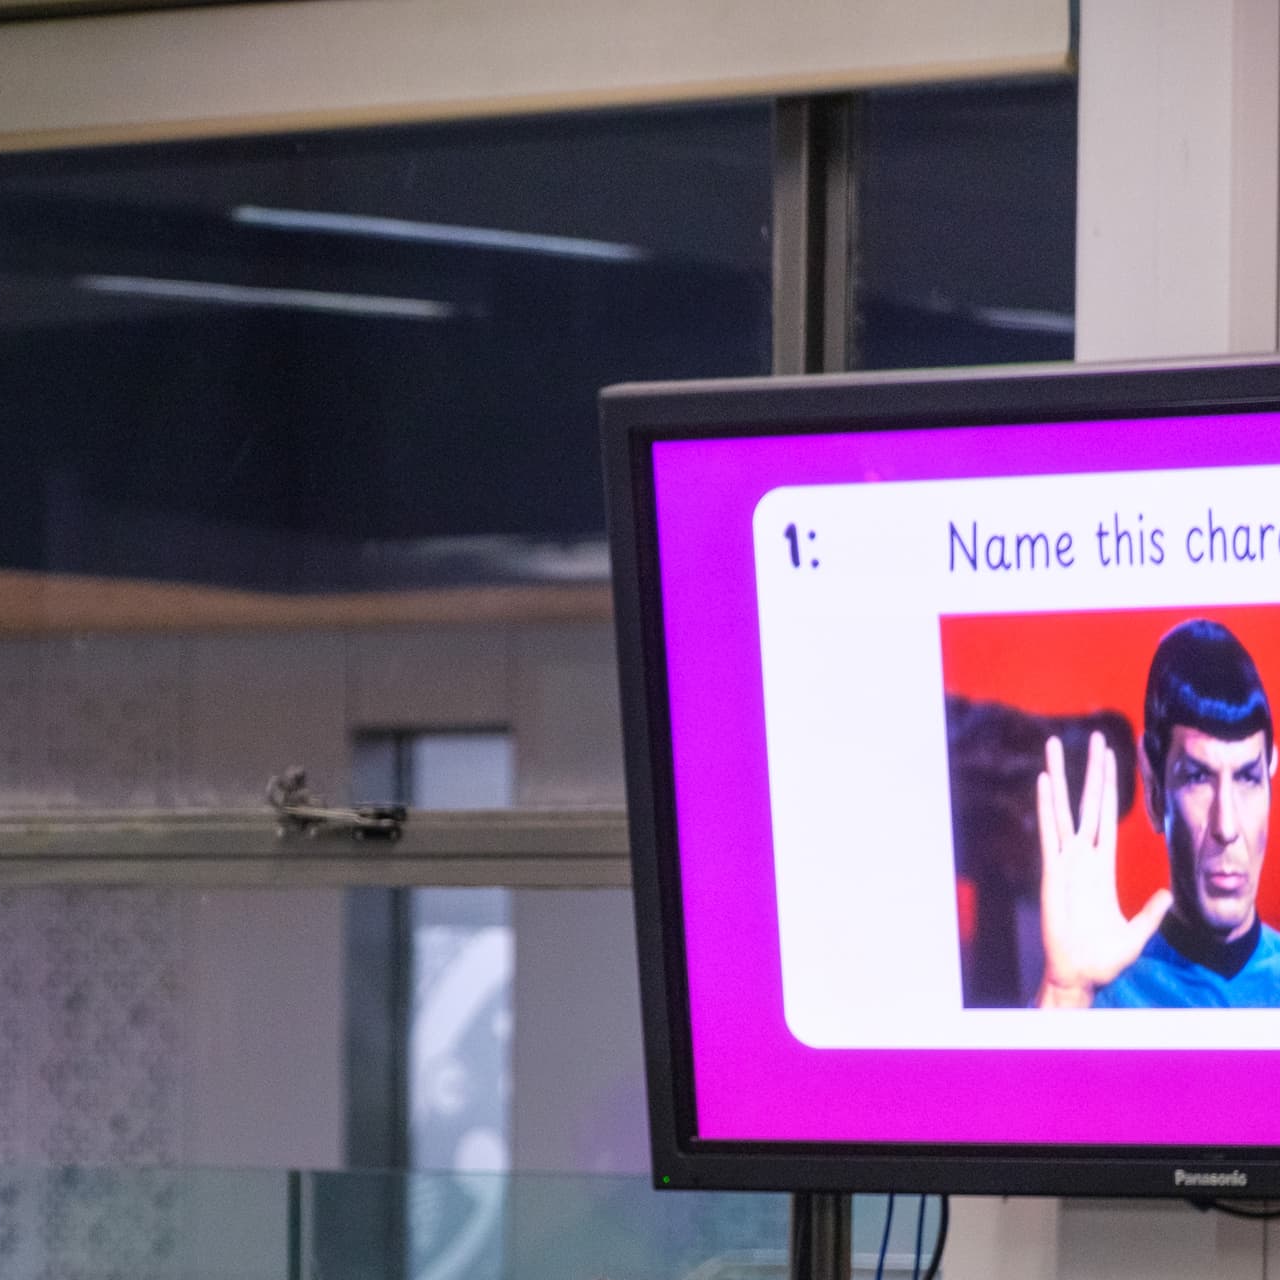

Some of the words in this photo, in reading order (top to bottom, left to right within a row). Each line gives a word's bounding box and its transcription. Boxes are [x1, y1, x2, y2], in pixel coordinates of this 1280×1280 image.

[784, 522, 820, 569] 1:
[948, 520, 1075, 572] Name
[1096, 511, 1165, 567] this
[1174, 1168, 1248, 1187] Panasonic
